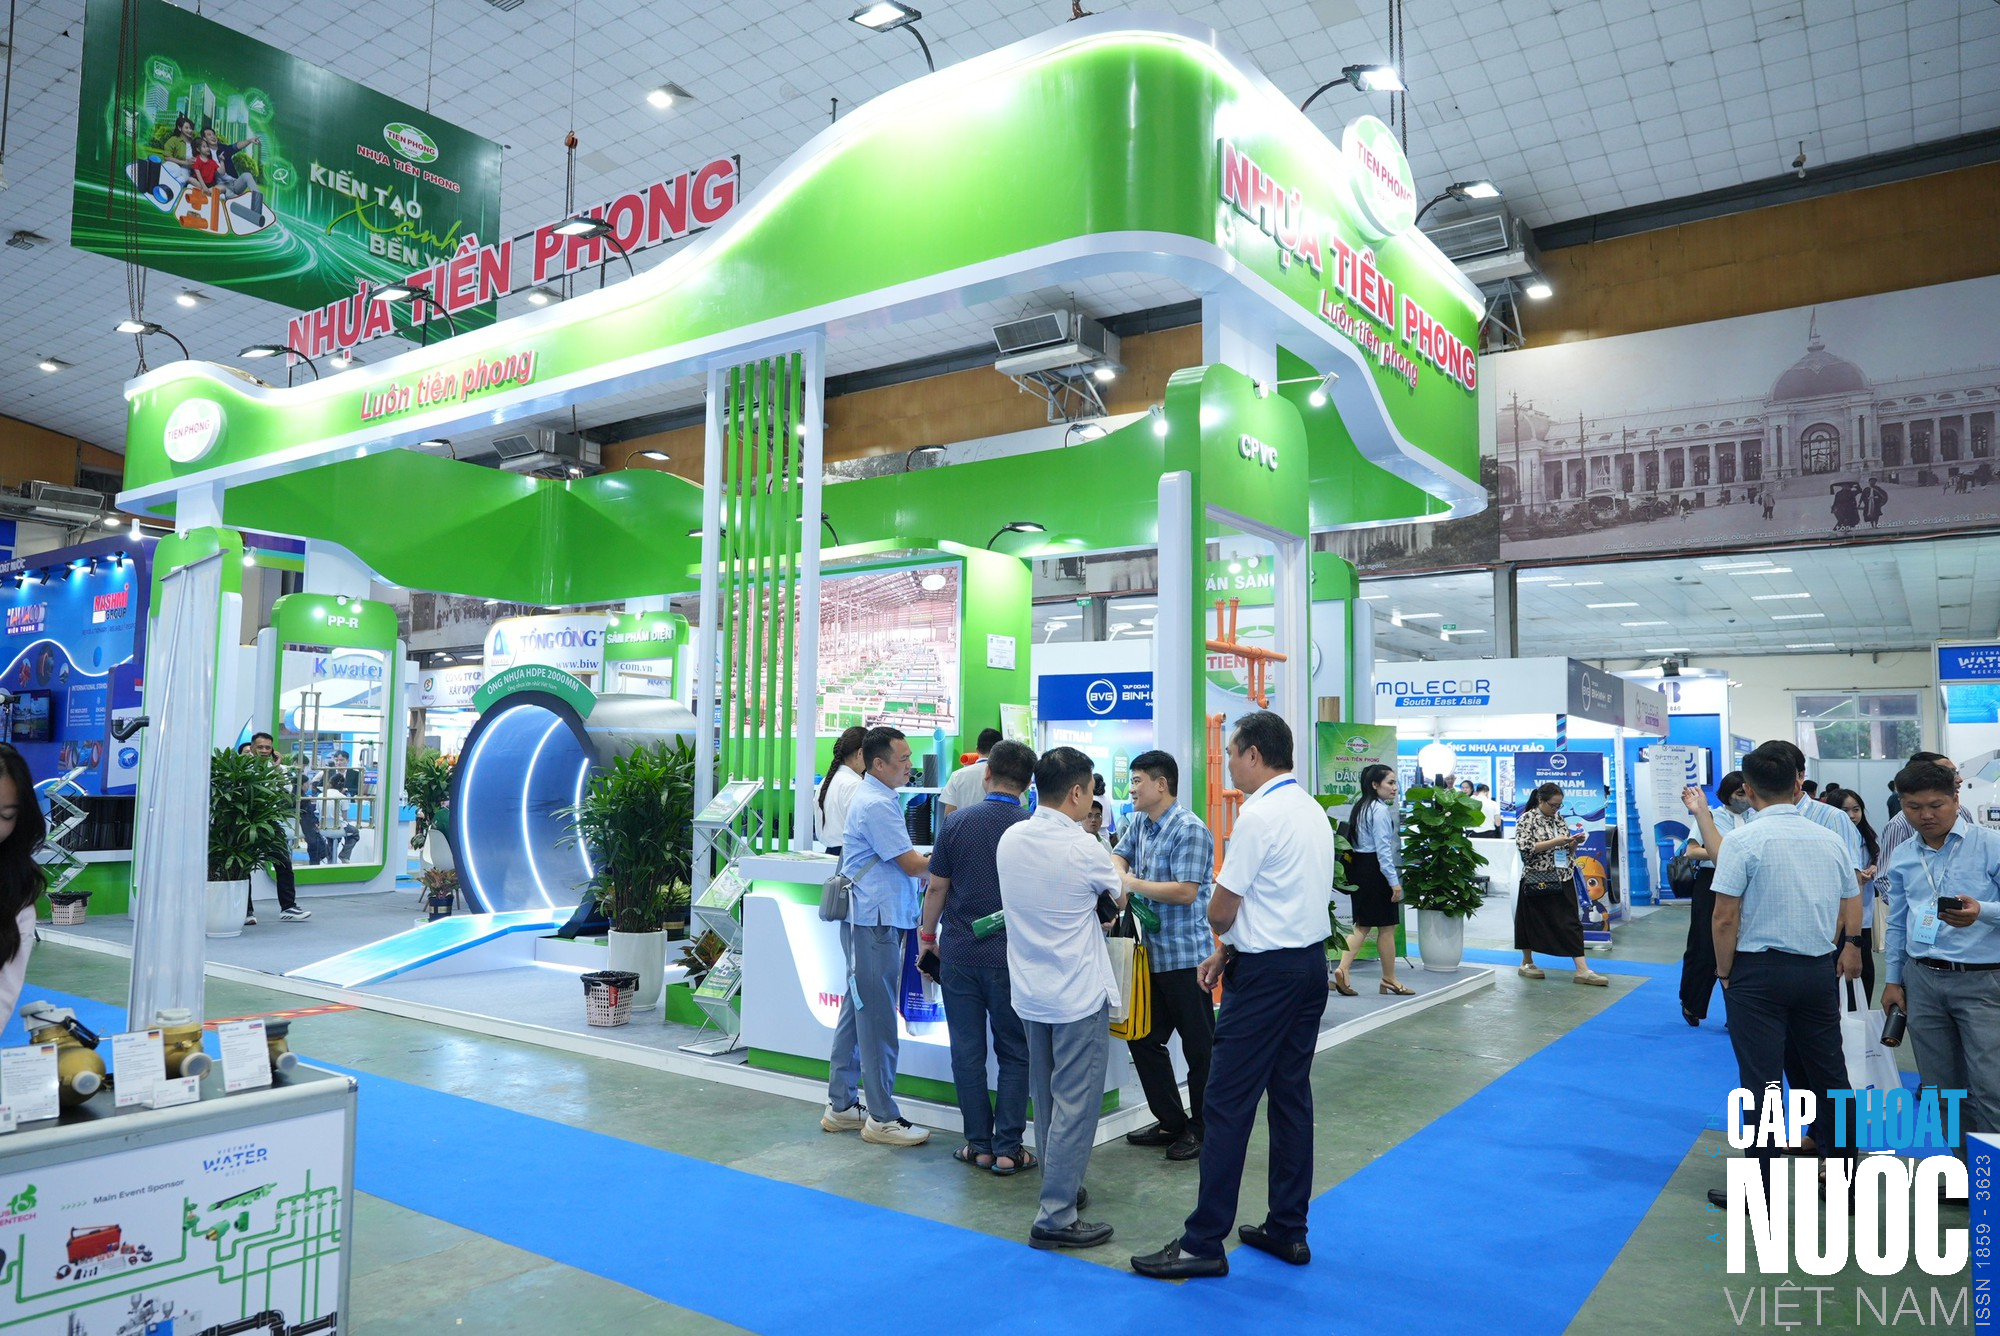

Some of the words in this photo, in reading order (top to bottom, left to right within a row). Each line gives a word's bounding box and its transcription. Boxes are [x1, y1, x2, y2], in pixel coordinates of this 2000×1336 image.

[407, 138, 436, 156] PHONG
[1357, 141, 1379, 177] TIEN
[357, 145, 390, 167] NHỰA
[424, 172, 460, 193] PHONG
[310, 163, 368, 201] KIẾN
[374, 187, 423, 219] TẠO
[286, 279, 396, 367] NHỰA
[405, 232, 513, 327] TIỀN
[532, 156, 738, 287] PHONG
[369, 232, 418, 267] BỀN
[1220, 139, 1323, 272] NHỰA
[1331, 235, 1395, 330] TIỀN
[1402, 294, 1476, 391] PHONG
[1321, 289, 1356, 337] Luôn
[1382, 341, 1418, 388] phong
[361, 384, 409, 420] Luôn
[417, 366, 456, 411] tiên
[461, 349, 536, 397] phong
[1238, 433, 1278, 470] CPVC
[94, 583, 129, 612] RASHMI
[105, 608, 127, 620] GROUP
[327, 615, 359, 628] PP-R
[520, 627, 555, 652] TỔNG
[555, 626, 597, 648] CÔNG
[606, 631, 624, 644] SẢN
[624, 629, 650, 643] PHẨM
[1206, 655, 1246, 670] TIEN
[487, 677, 503, 695] ỐNG
[503, 668, 525, 684] NHỰA
[526, 667, 546, 678] HDPE
[547, 669, 580, 692] 2000MM
[1376, 678, 1490, 696] MOLECOR
[1090, 692, 1113, 701] BVG
[1403, 697, 1431, 707] South
[1434, 697, 1458, 707] East
[1460, 697, 1482, 706] Asia
[1468, 742, 1497, 754] NHỰA
[1500, 744, 1521, 752] HUY
[1523, 742, 1545, 752] BẢO
[1566, 789, 1597, 797] WEEK
[203, 1148, 268, 1174] WATER
[93, 1194, 117, 1204] Main
[119, 1187, 145, 1199] Event
[147, 1179, 184, 1193] Sponsor
